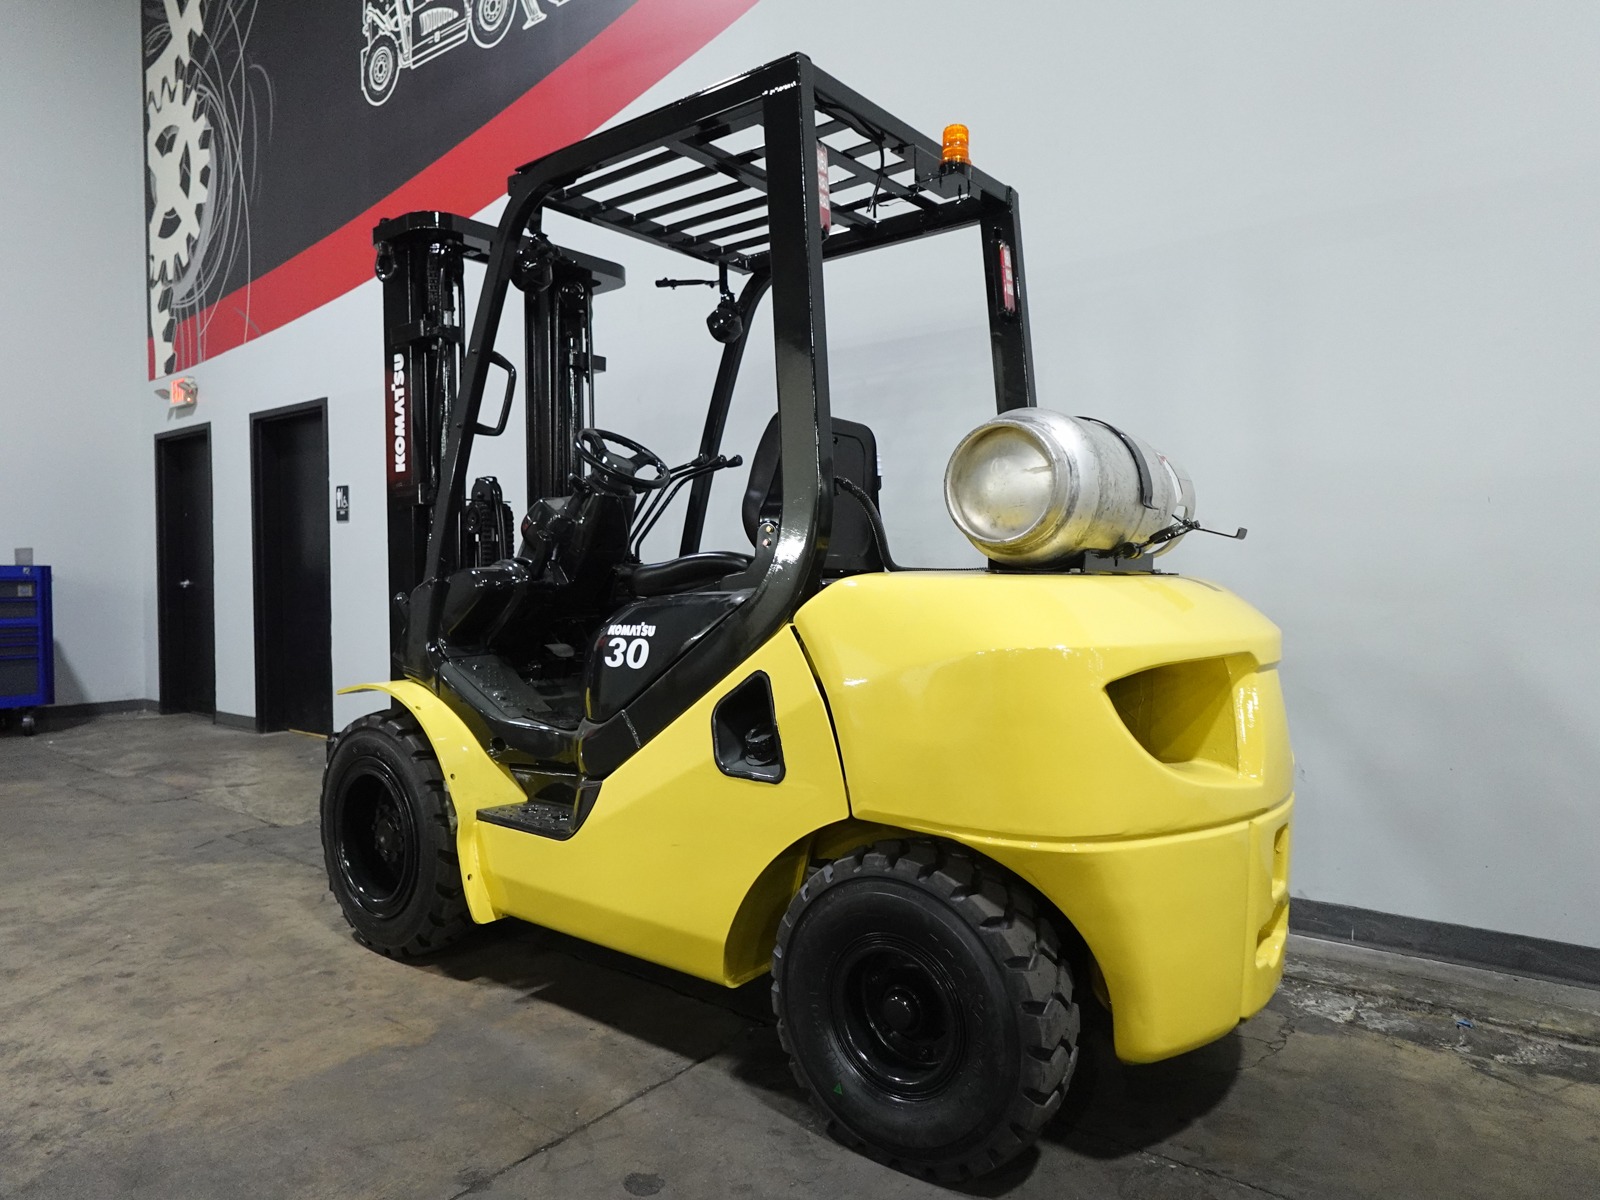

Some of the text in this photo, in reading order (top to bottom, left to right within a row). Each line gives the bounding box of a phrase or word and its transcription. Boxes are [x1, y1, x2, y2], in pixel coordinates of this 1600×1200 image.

[391, 353, 406, 472] KOMATSU
[607, 621, 656, 637] KOMATSU
[604, 637, 650, 669] 30
